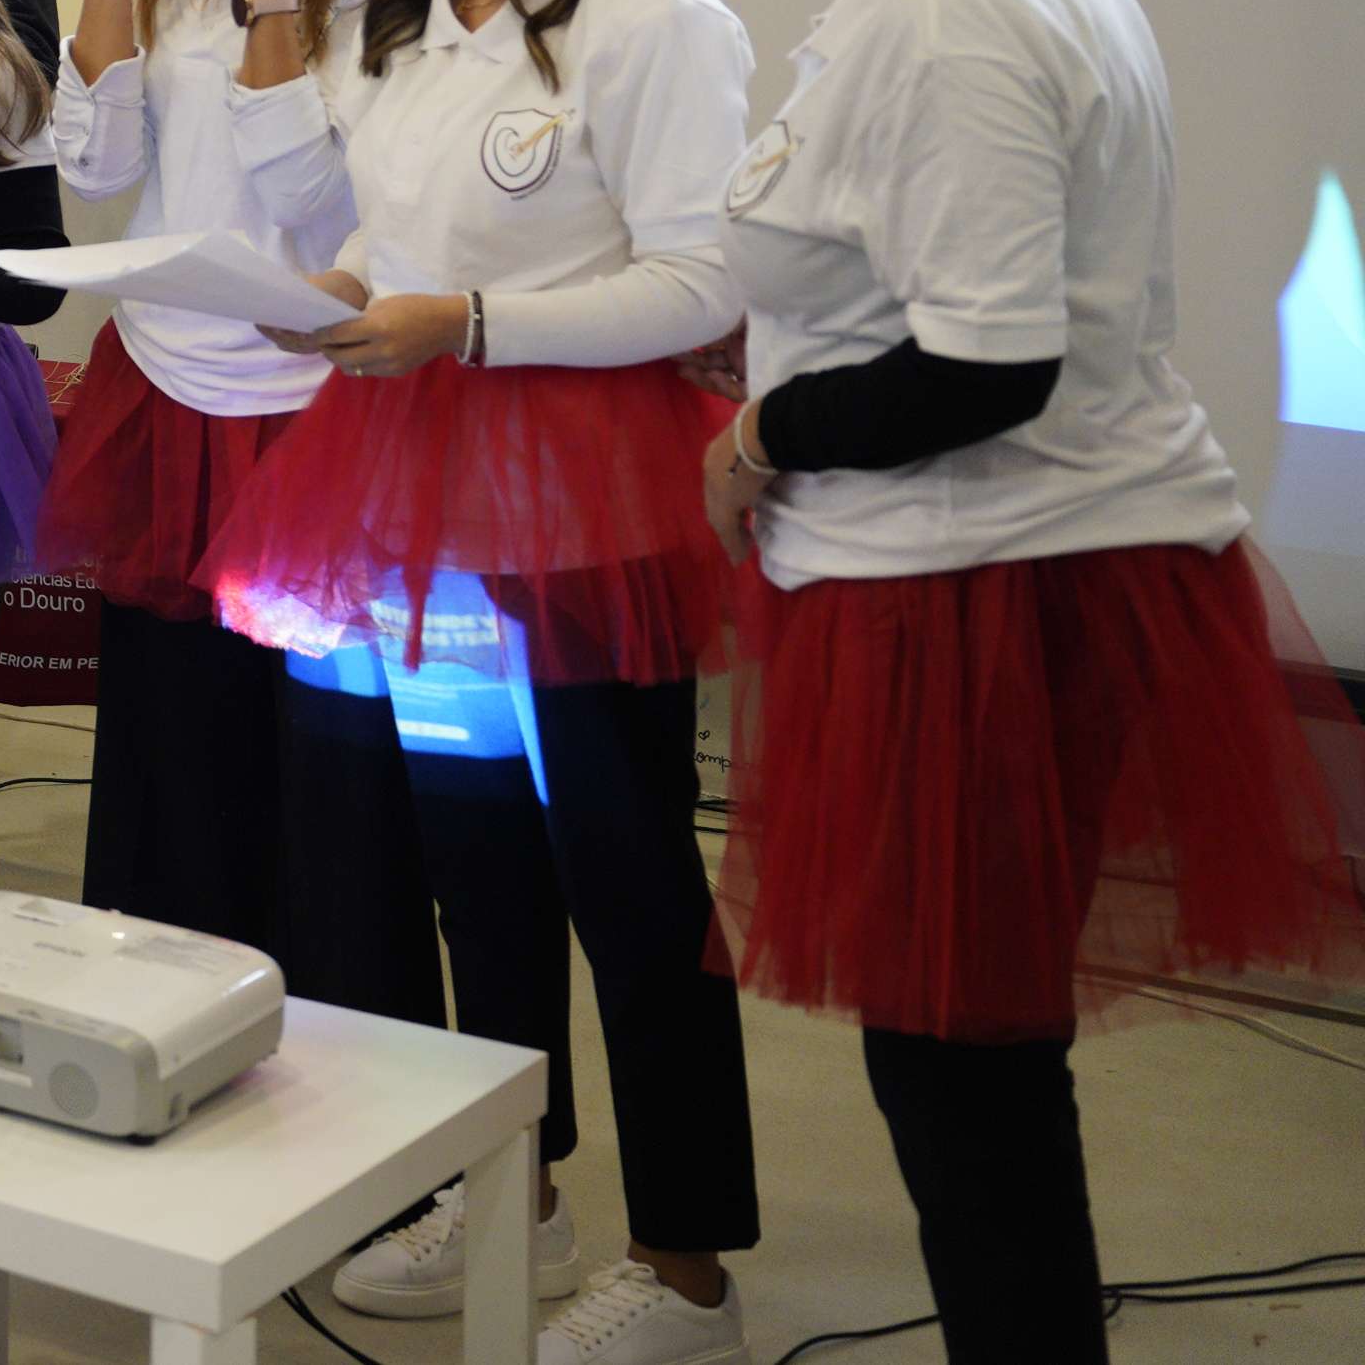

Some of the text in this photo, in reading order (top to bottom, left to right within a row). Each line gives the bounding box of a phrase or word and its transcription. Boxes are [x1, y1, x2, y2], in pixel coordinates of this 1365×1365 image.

[20, 587, 85, 612] Douro
[48, 657, 72, 669] EM
[77, 656, 99, 669] PE
